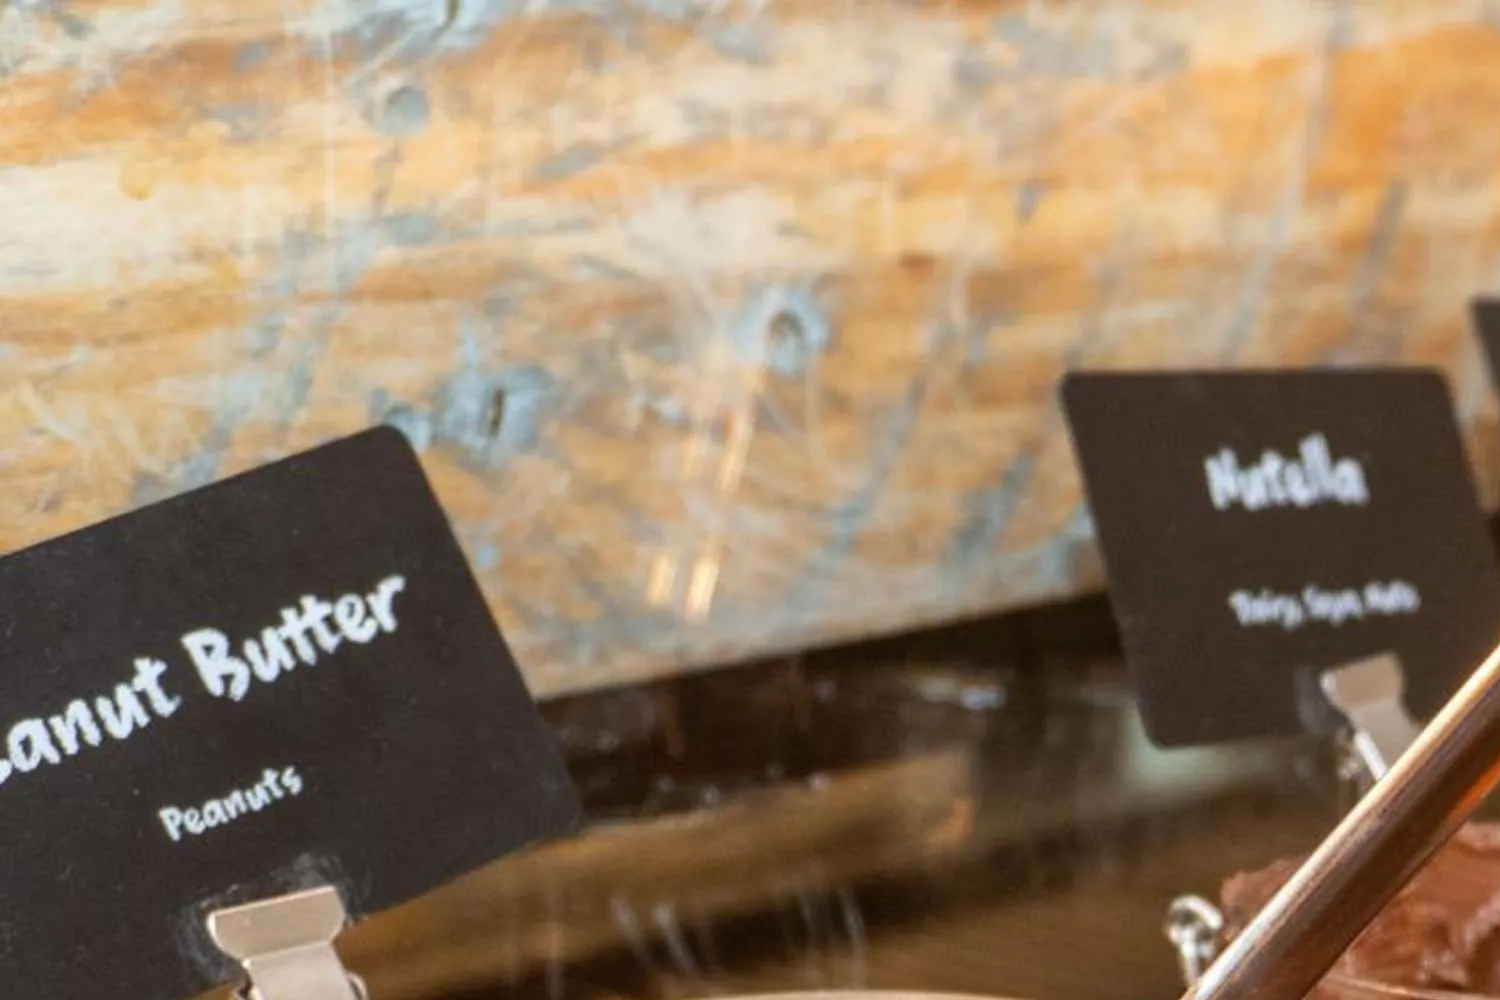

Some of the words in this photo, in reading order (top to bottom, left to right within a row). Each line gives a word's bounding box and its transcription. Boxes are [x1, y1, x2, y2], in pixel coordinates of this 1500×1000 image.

[1206, 434, 1368, 510] Nutella
[0, 657, 180, 784] anut
[181, 575, 405, 702] Butter
[159, 766, 303, 841] Peanuts
